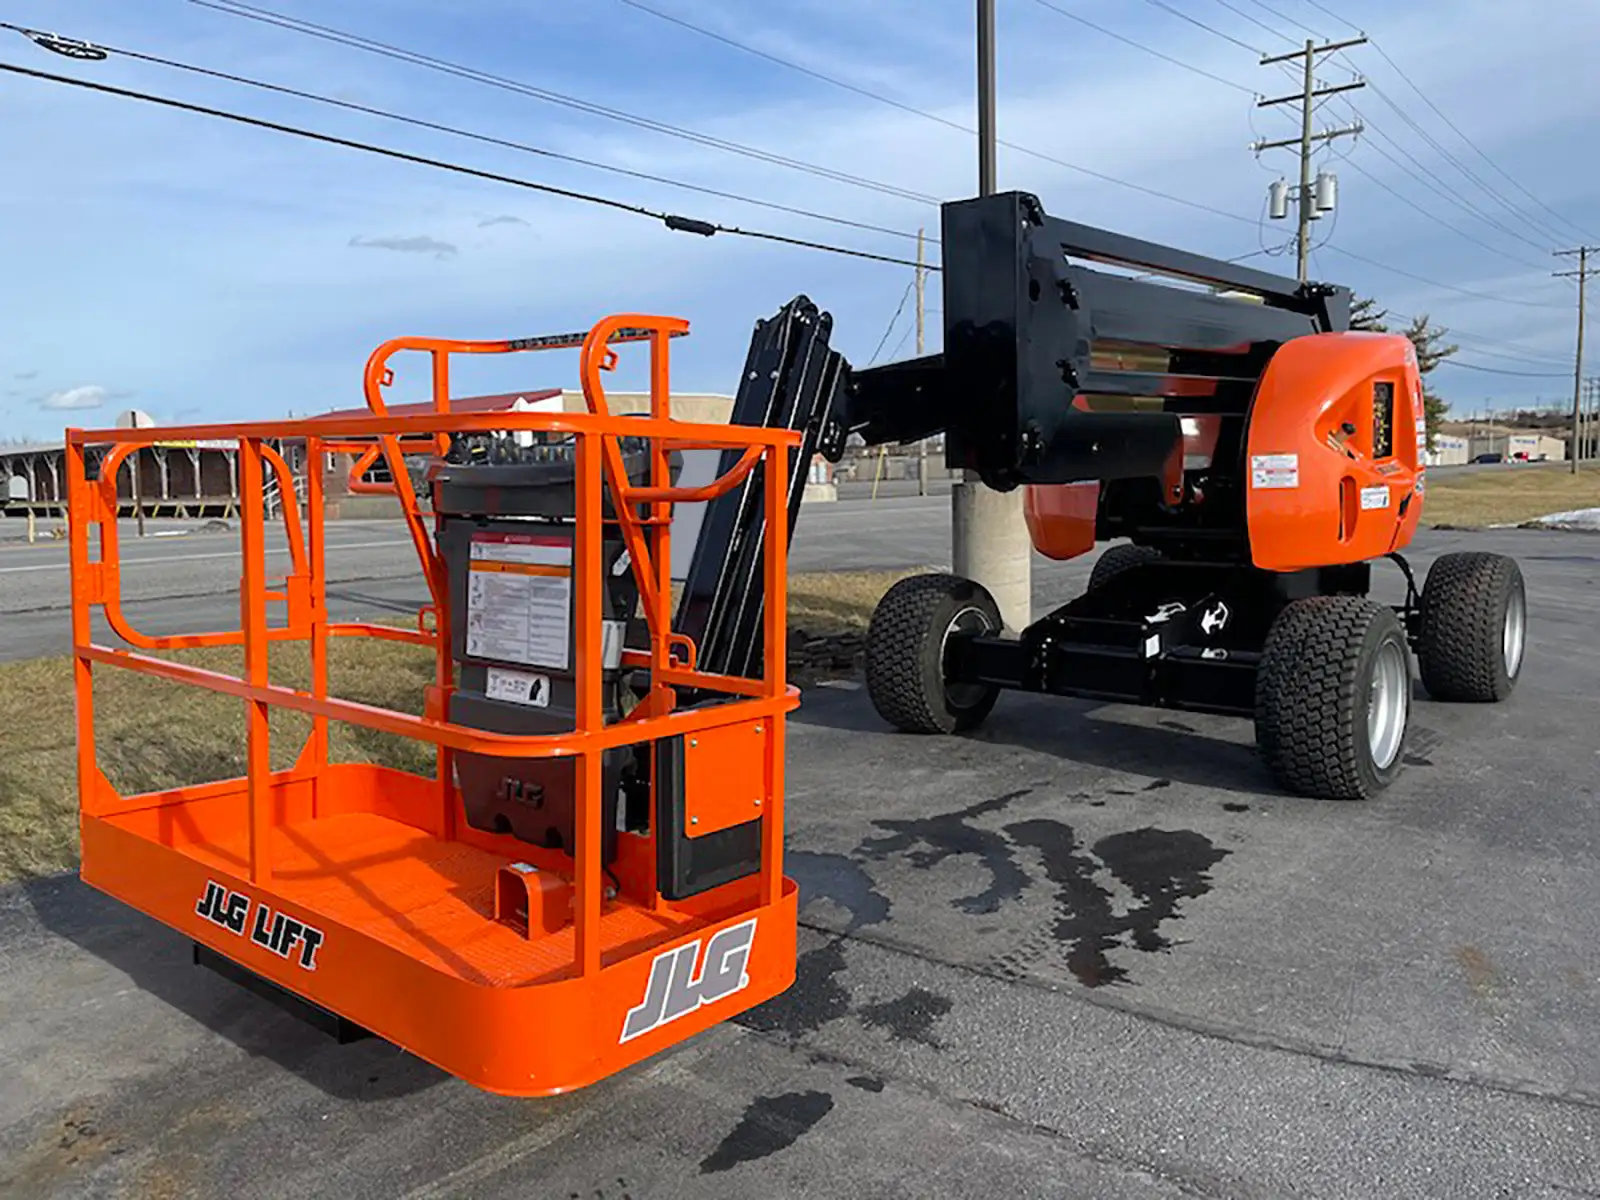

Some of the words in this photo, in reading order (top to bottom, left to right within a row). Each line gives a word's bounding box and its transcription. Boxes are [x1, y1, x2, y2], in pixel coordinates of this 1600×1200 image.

[195, 880, 251, 936] JLG
[250, 903, 324, 970] LIFT
[619, 918, 757, 1044] JLG
